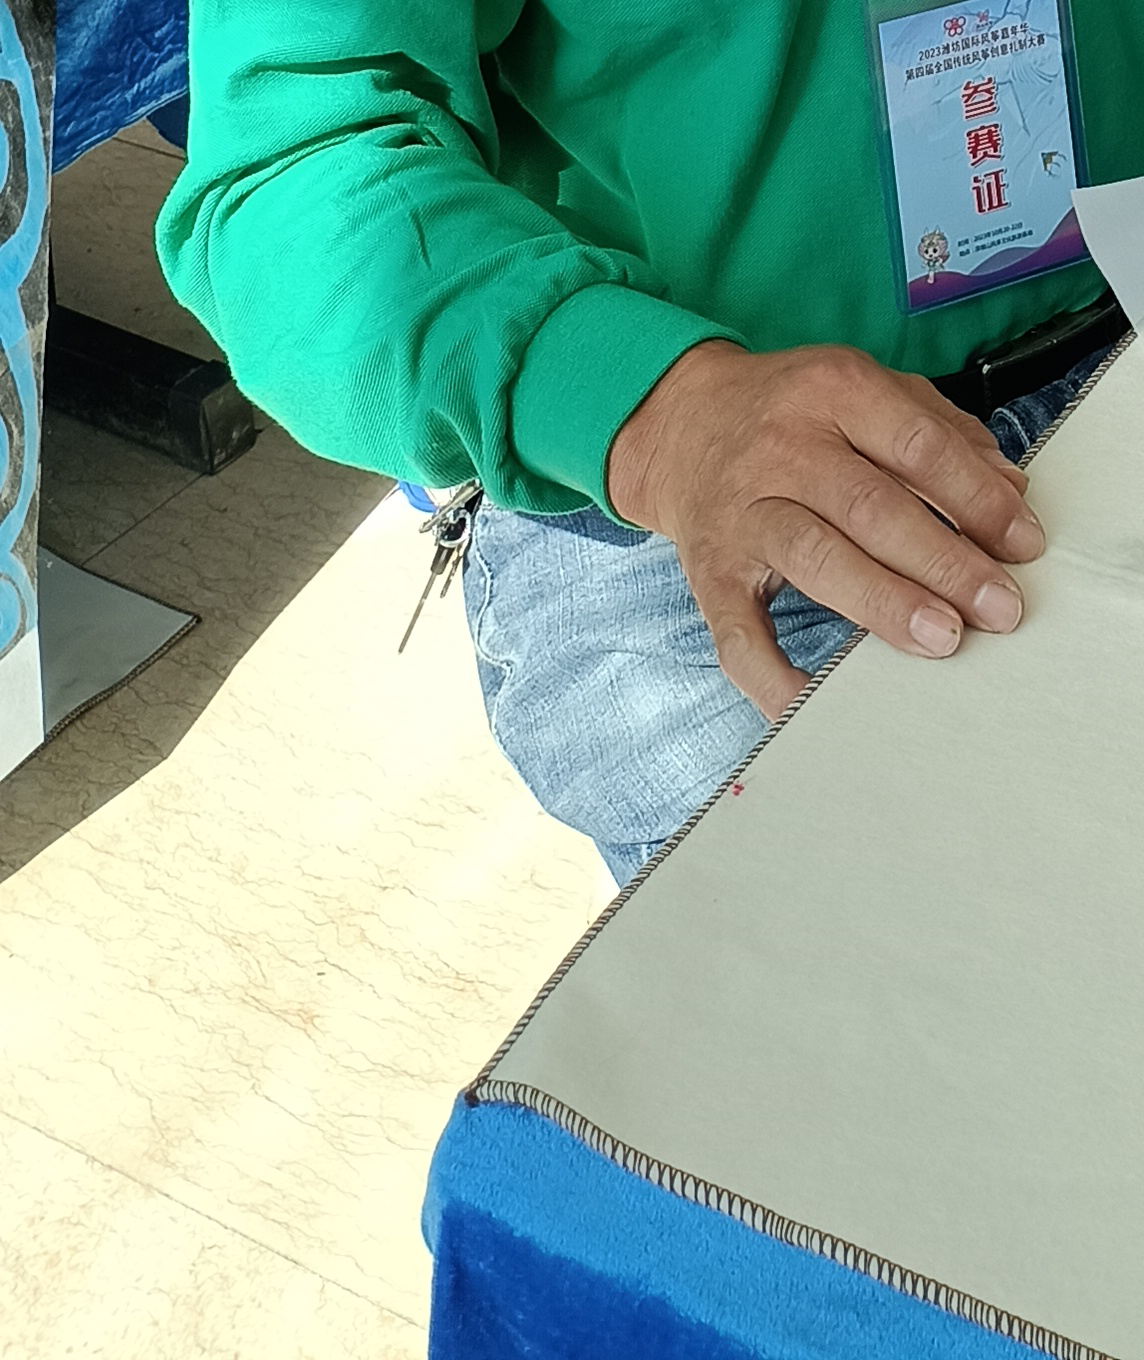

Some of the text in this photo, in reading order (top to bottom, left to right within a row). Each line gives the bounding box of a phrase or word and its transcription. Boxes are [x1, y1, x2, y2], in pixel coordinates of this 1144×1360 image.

[919, 22, 1029, 61] 2023潍坊国际风筝嘉年华
[962, 77, 1009, 213] 参赛证
